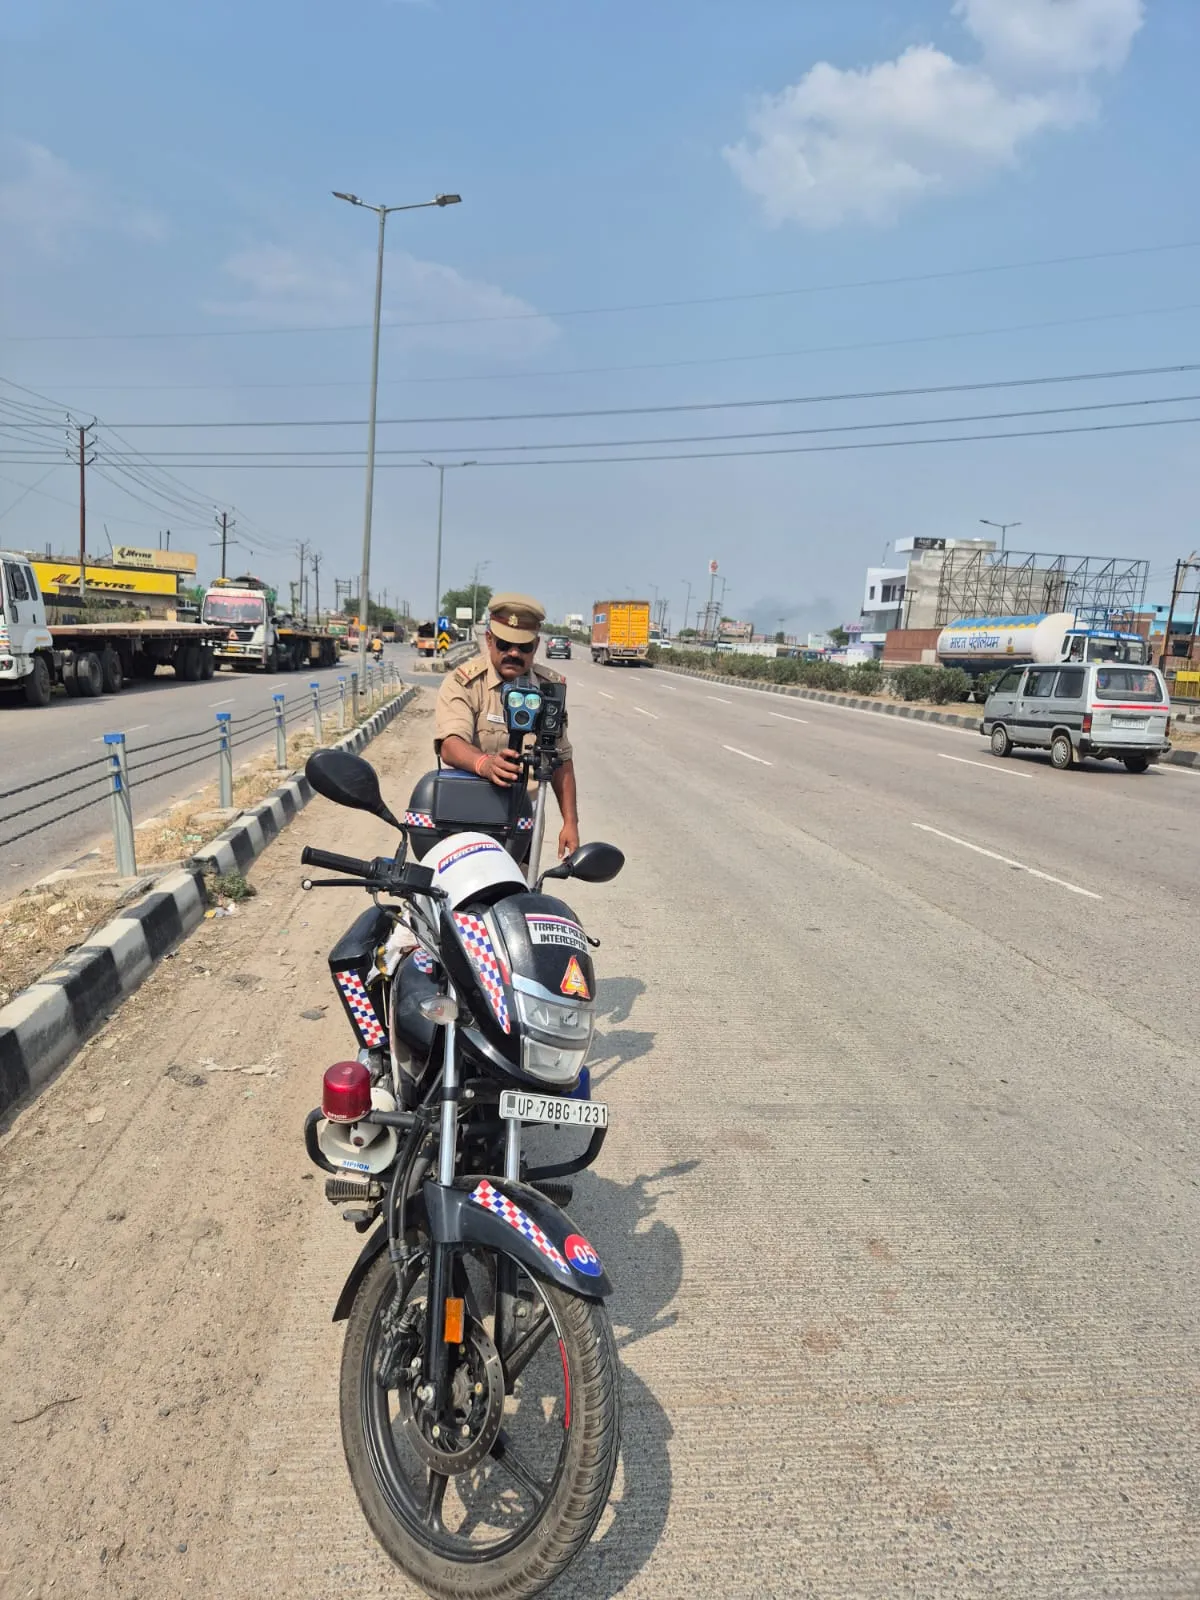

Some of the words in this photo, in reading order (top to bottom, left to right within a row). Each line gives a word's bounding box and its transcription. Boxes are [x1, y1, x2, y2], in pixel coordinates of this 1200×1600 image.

[533, 922, 568, 935] TRAFFIC
[518, 1097, 533, 1117] UP
[539, 1100, 570, 1120] 78BG
[578, 1105, 606, 1123] 1231
[343, 1160, 370, 1171] SIPHON
[573, 1244, 597, 1265] 05
